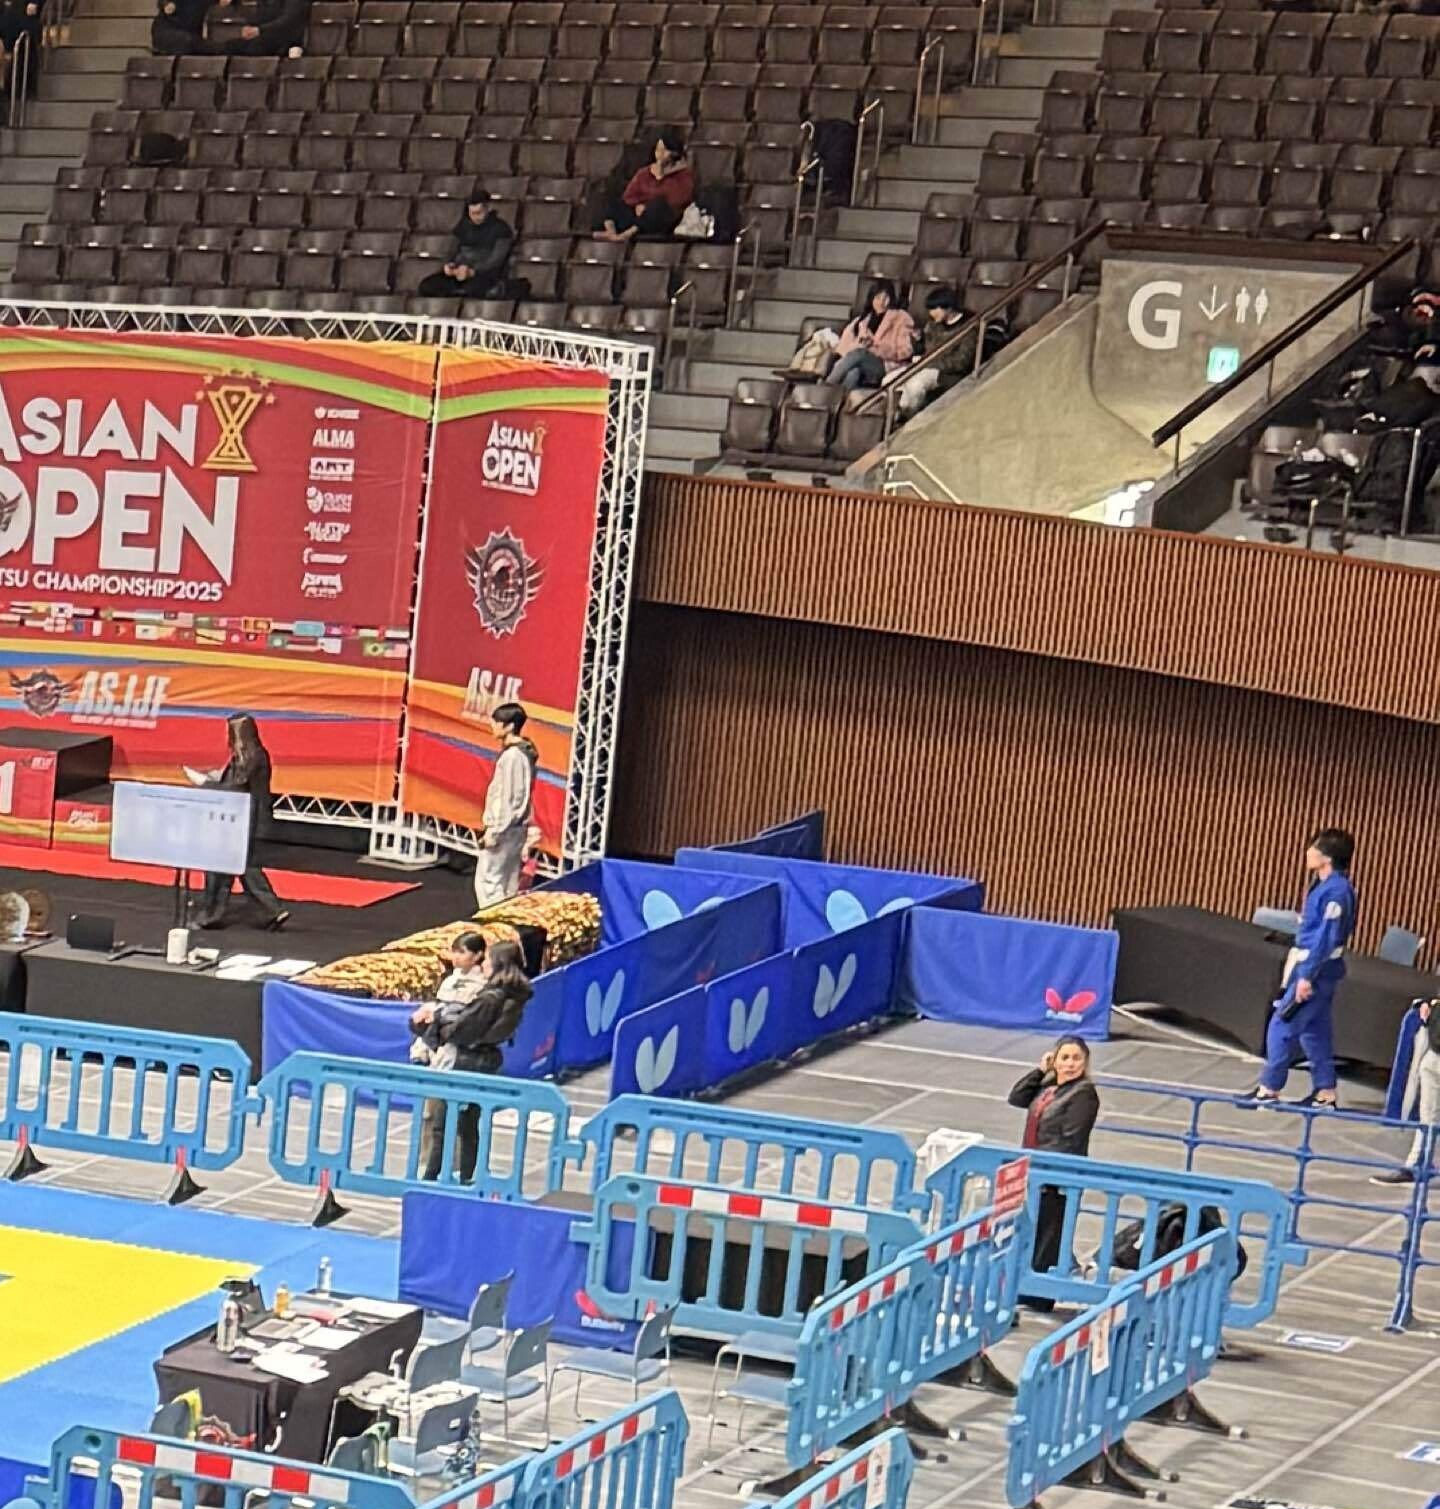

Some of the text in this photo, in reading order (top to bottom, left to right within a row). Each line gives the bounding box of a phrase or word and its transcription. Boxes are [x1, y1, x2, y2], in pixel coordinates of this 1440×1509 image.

[1127, 280, 1183, 350] G
[312, 428, 355, 450] ALMA
[487, 420, 535, 451] ASIAN
[482, 447, 541, 490] OPEN
[73, 671, 172, 718] ASJJF
